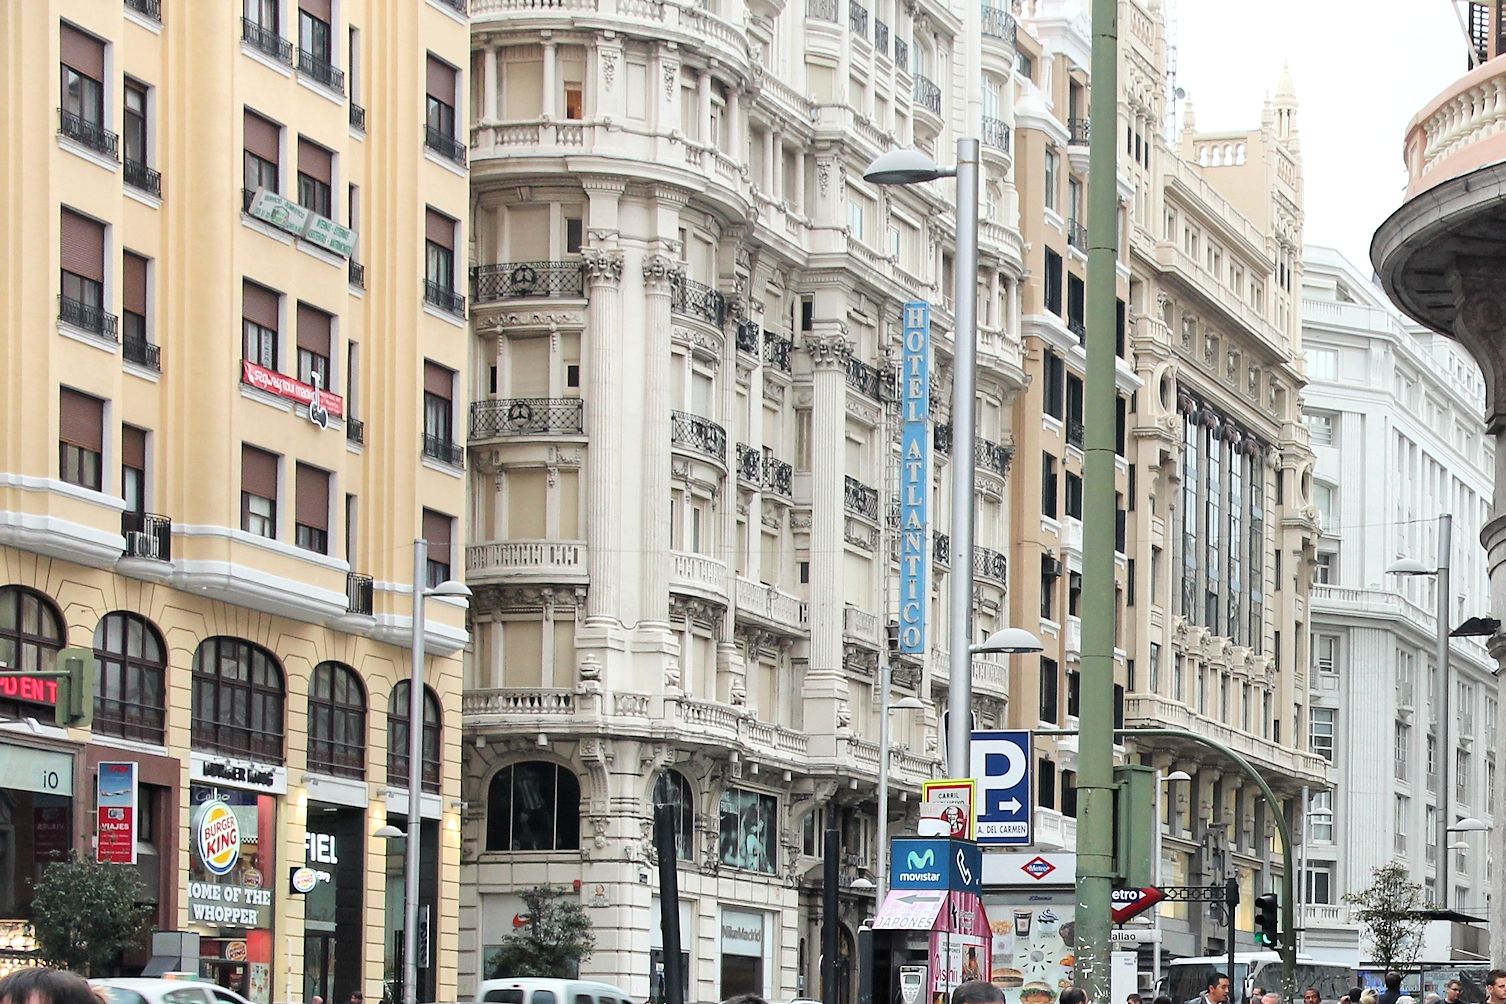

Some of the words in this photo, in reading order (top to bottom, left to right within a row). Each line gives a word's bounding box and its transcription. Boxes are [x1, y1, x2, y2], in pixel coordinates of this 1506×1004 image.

[907, 307, 925, 423] HOTEL
[903, 438, 923, 650] ATLANTICO
[971, 740, 1027, 816] P
[101, 822, 130, 831] VIAJES
[204, 816, 236, 839] BURGER
[986, 825, 998, 834] DEL
[999, 825, 1027, 834] CARMEN
[205, 828, 238, 859] KING
[900, 872, 941, 882] movistar
[1029, 864, 1048, 872] Metro
[226, 885, 242, 902] OF
[243, 886, 271, 906] THE
[1112, 889, 1138, 900] etro
[192, 905, 258, 925] WHOPPER
[1112, 931, 1136, 941] allao
